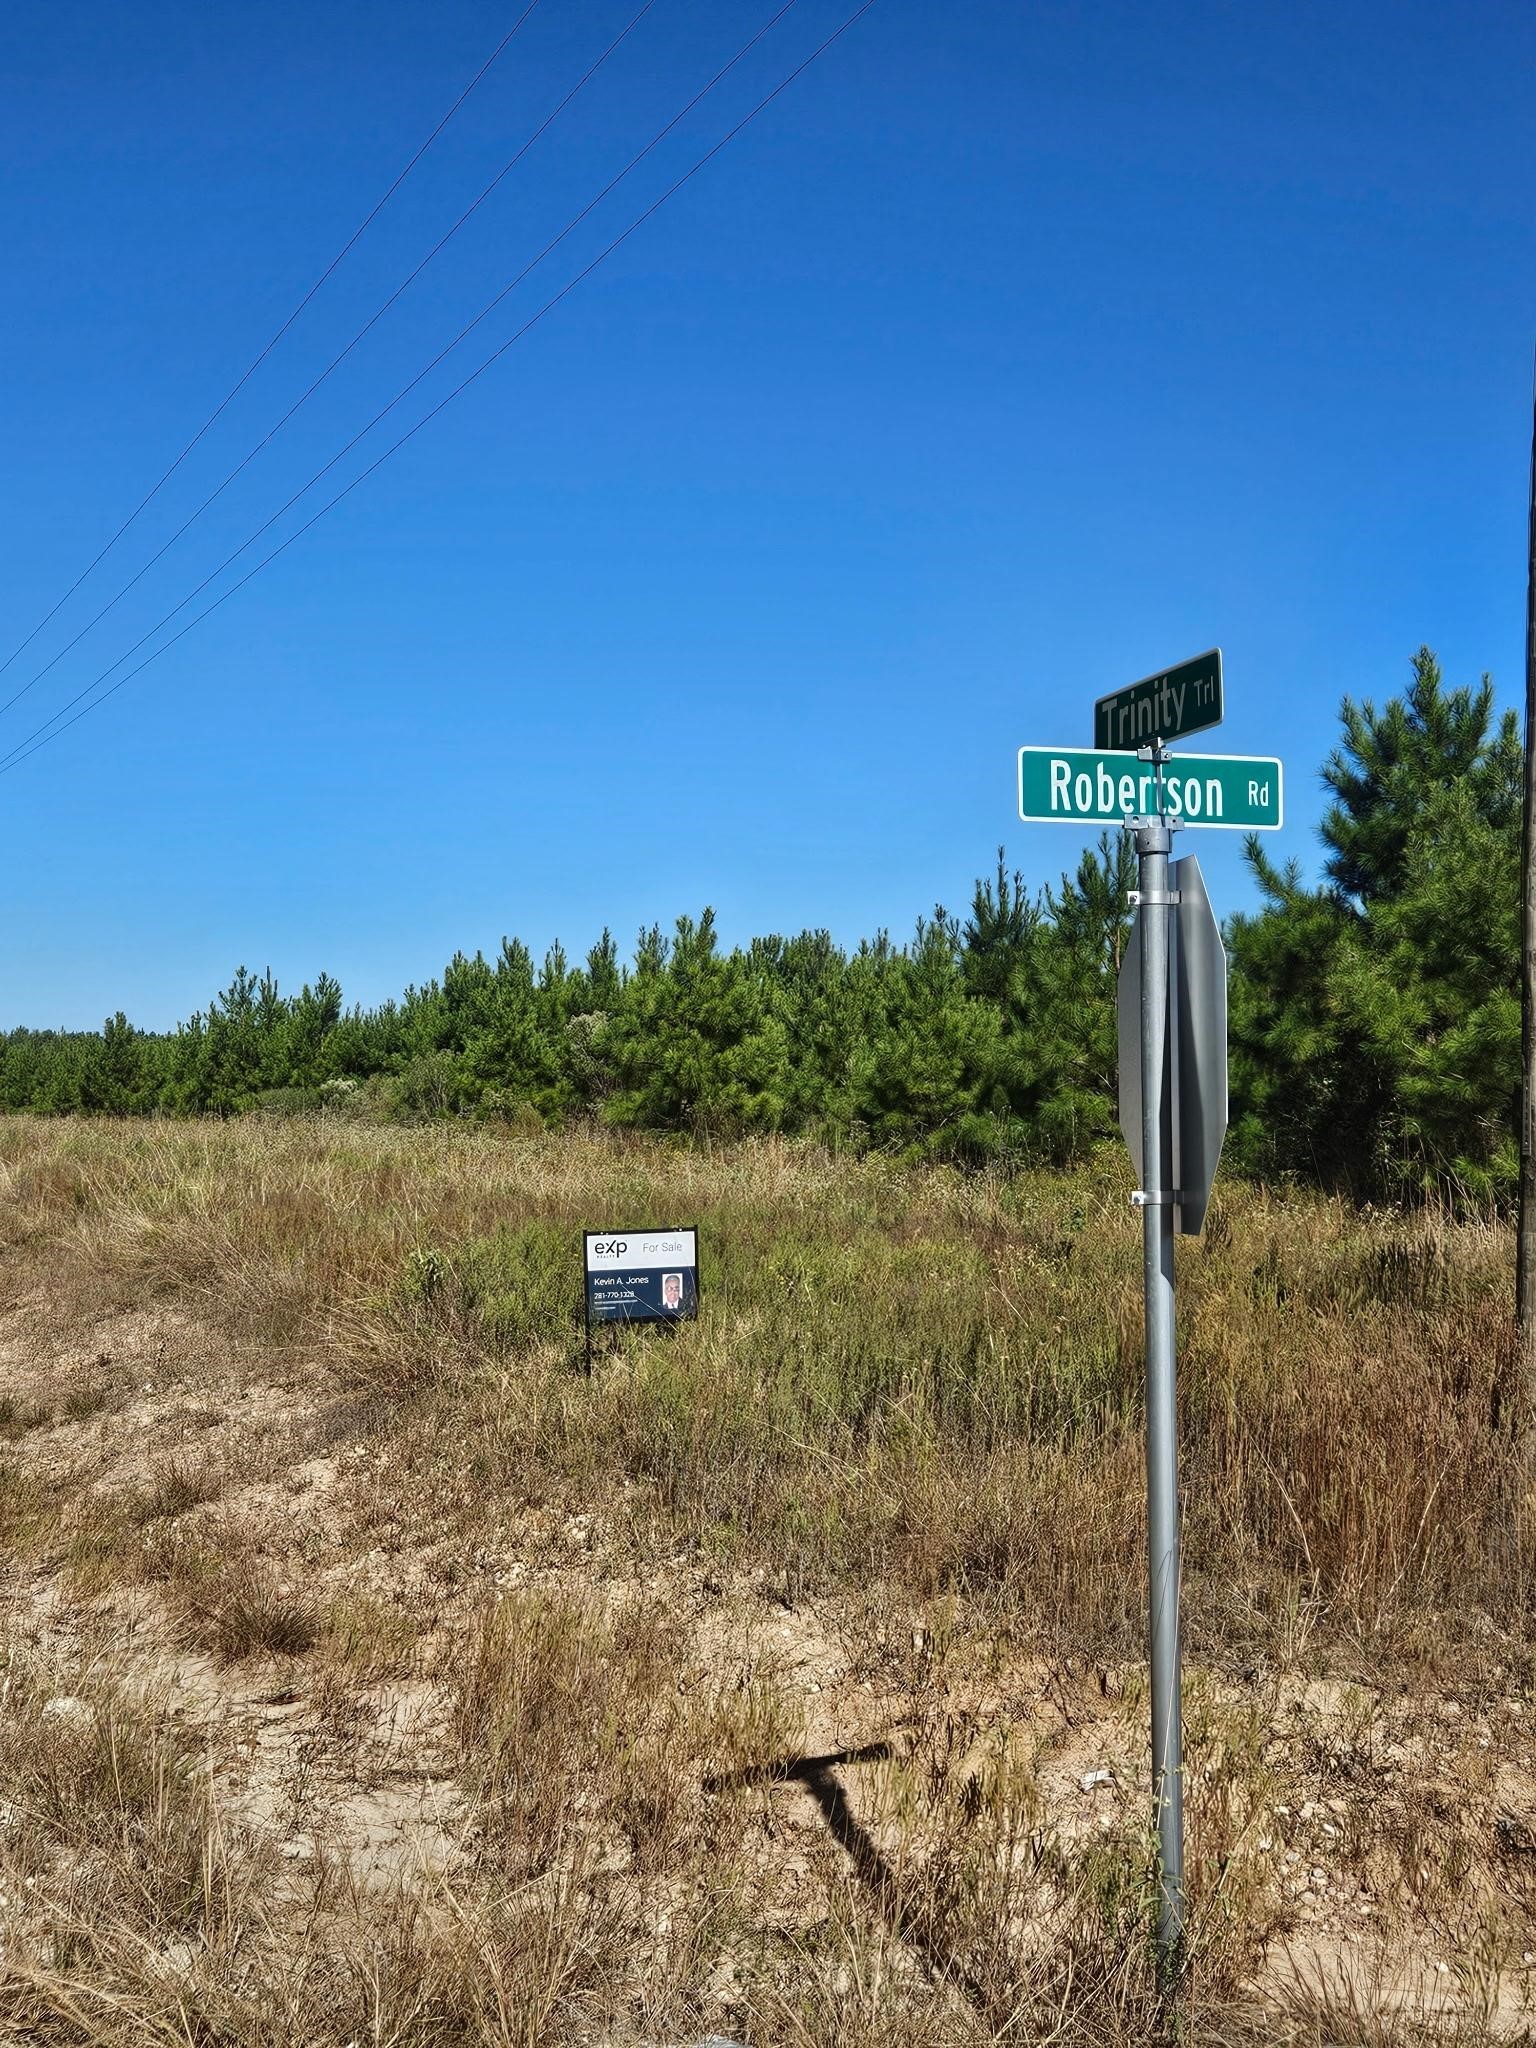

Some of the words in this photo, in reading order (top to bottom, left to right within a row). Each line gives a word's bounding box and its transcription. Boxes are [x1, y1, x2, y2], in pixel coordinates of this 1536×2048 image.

[1102, 677, 1186, 749] Trinity
[1194, 675, 1214, 707] Trl
[1050, 759, 1223, 817] Robertson
[1248, 780, 1269, 807] Rd
[643, 1243, 659, 1253] For
[661, 1242, 682, 1252] Sale
[594, 1277, 615, 1286] Kevin
[625, 1276, 649, 1285] Jones
